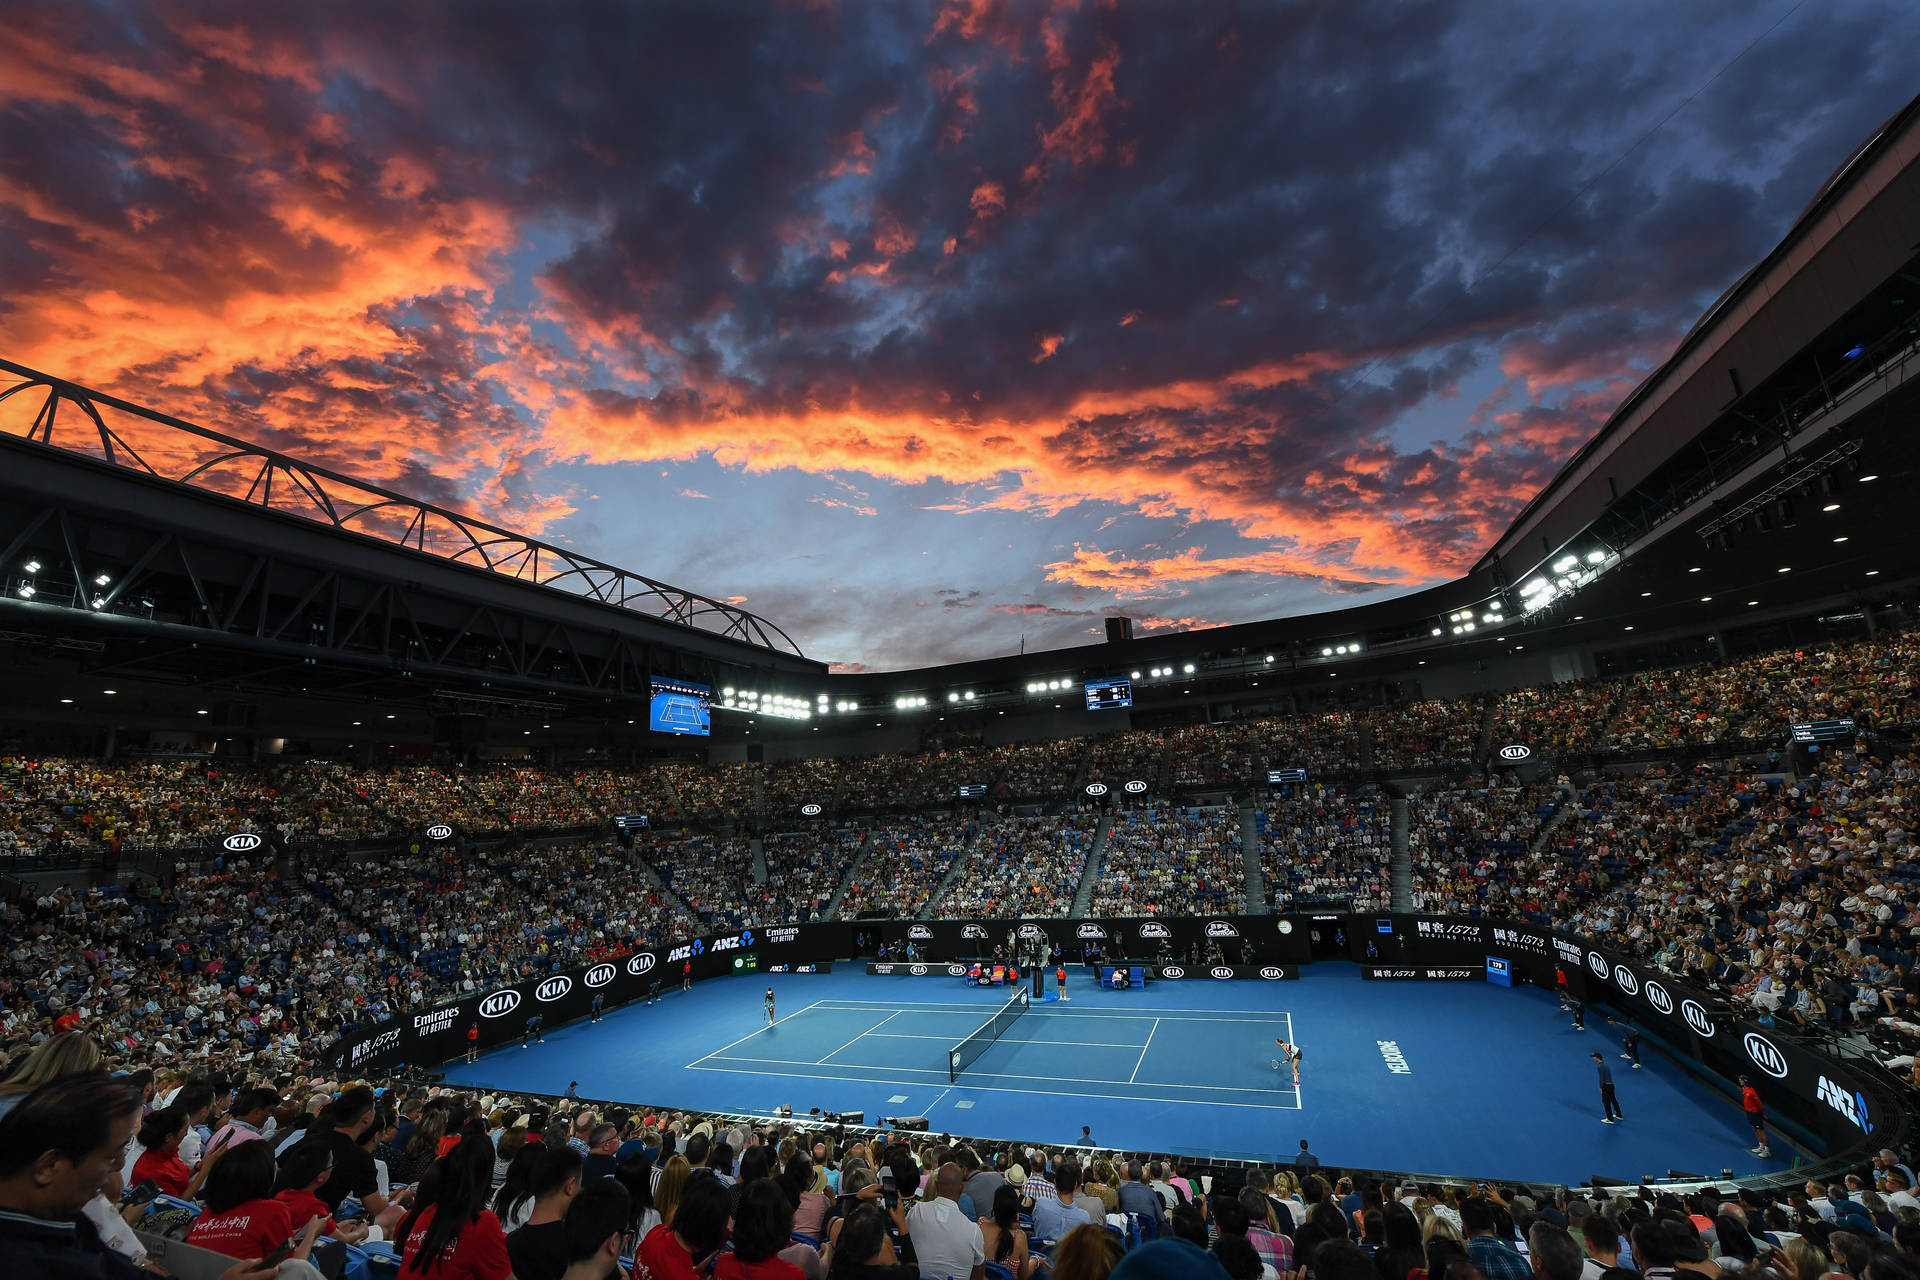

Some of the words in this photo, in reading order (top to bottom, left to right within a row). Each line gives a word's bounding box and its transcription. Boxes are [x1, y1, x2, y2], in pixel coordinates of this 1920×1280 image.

[1505, 748, 1525, 756] KIA
[431, 828, 448, 836] KIA
[230, 838, 255, 848] KIA
[766, 927, 799, 937] Emirates
[711, 936, 740, 952] ANZ
[1552, 936, 1581, 956] Emirates
[667, 945, 691, 963] ANZ
[632, 956, 651, 972] KIA
[1591, 956, 1606, 975] KIA
[590, 968, 611, 984] KIA
[1618, 969, 1635, 991] KIA
[542, 980, 566, 998] KIA
[1649, 985, 1670, 1010] KIA
[486, 994, 514, 1014] KIA
[414, 1006, 459, 1027] Emirates
[1686, 1004, 1710, 1032] KIA
[419, 1025, 429, 1037] FLY
[430, 1019, 452, 1034] BETTER
[1749, 1038, 1783, 1073] KIA
[1817, 1075, 1860, 1128] ANZ
